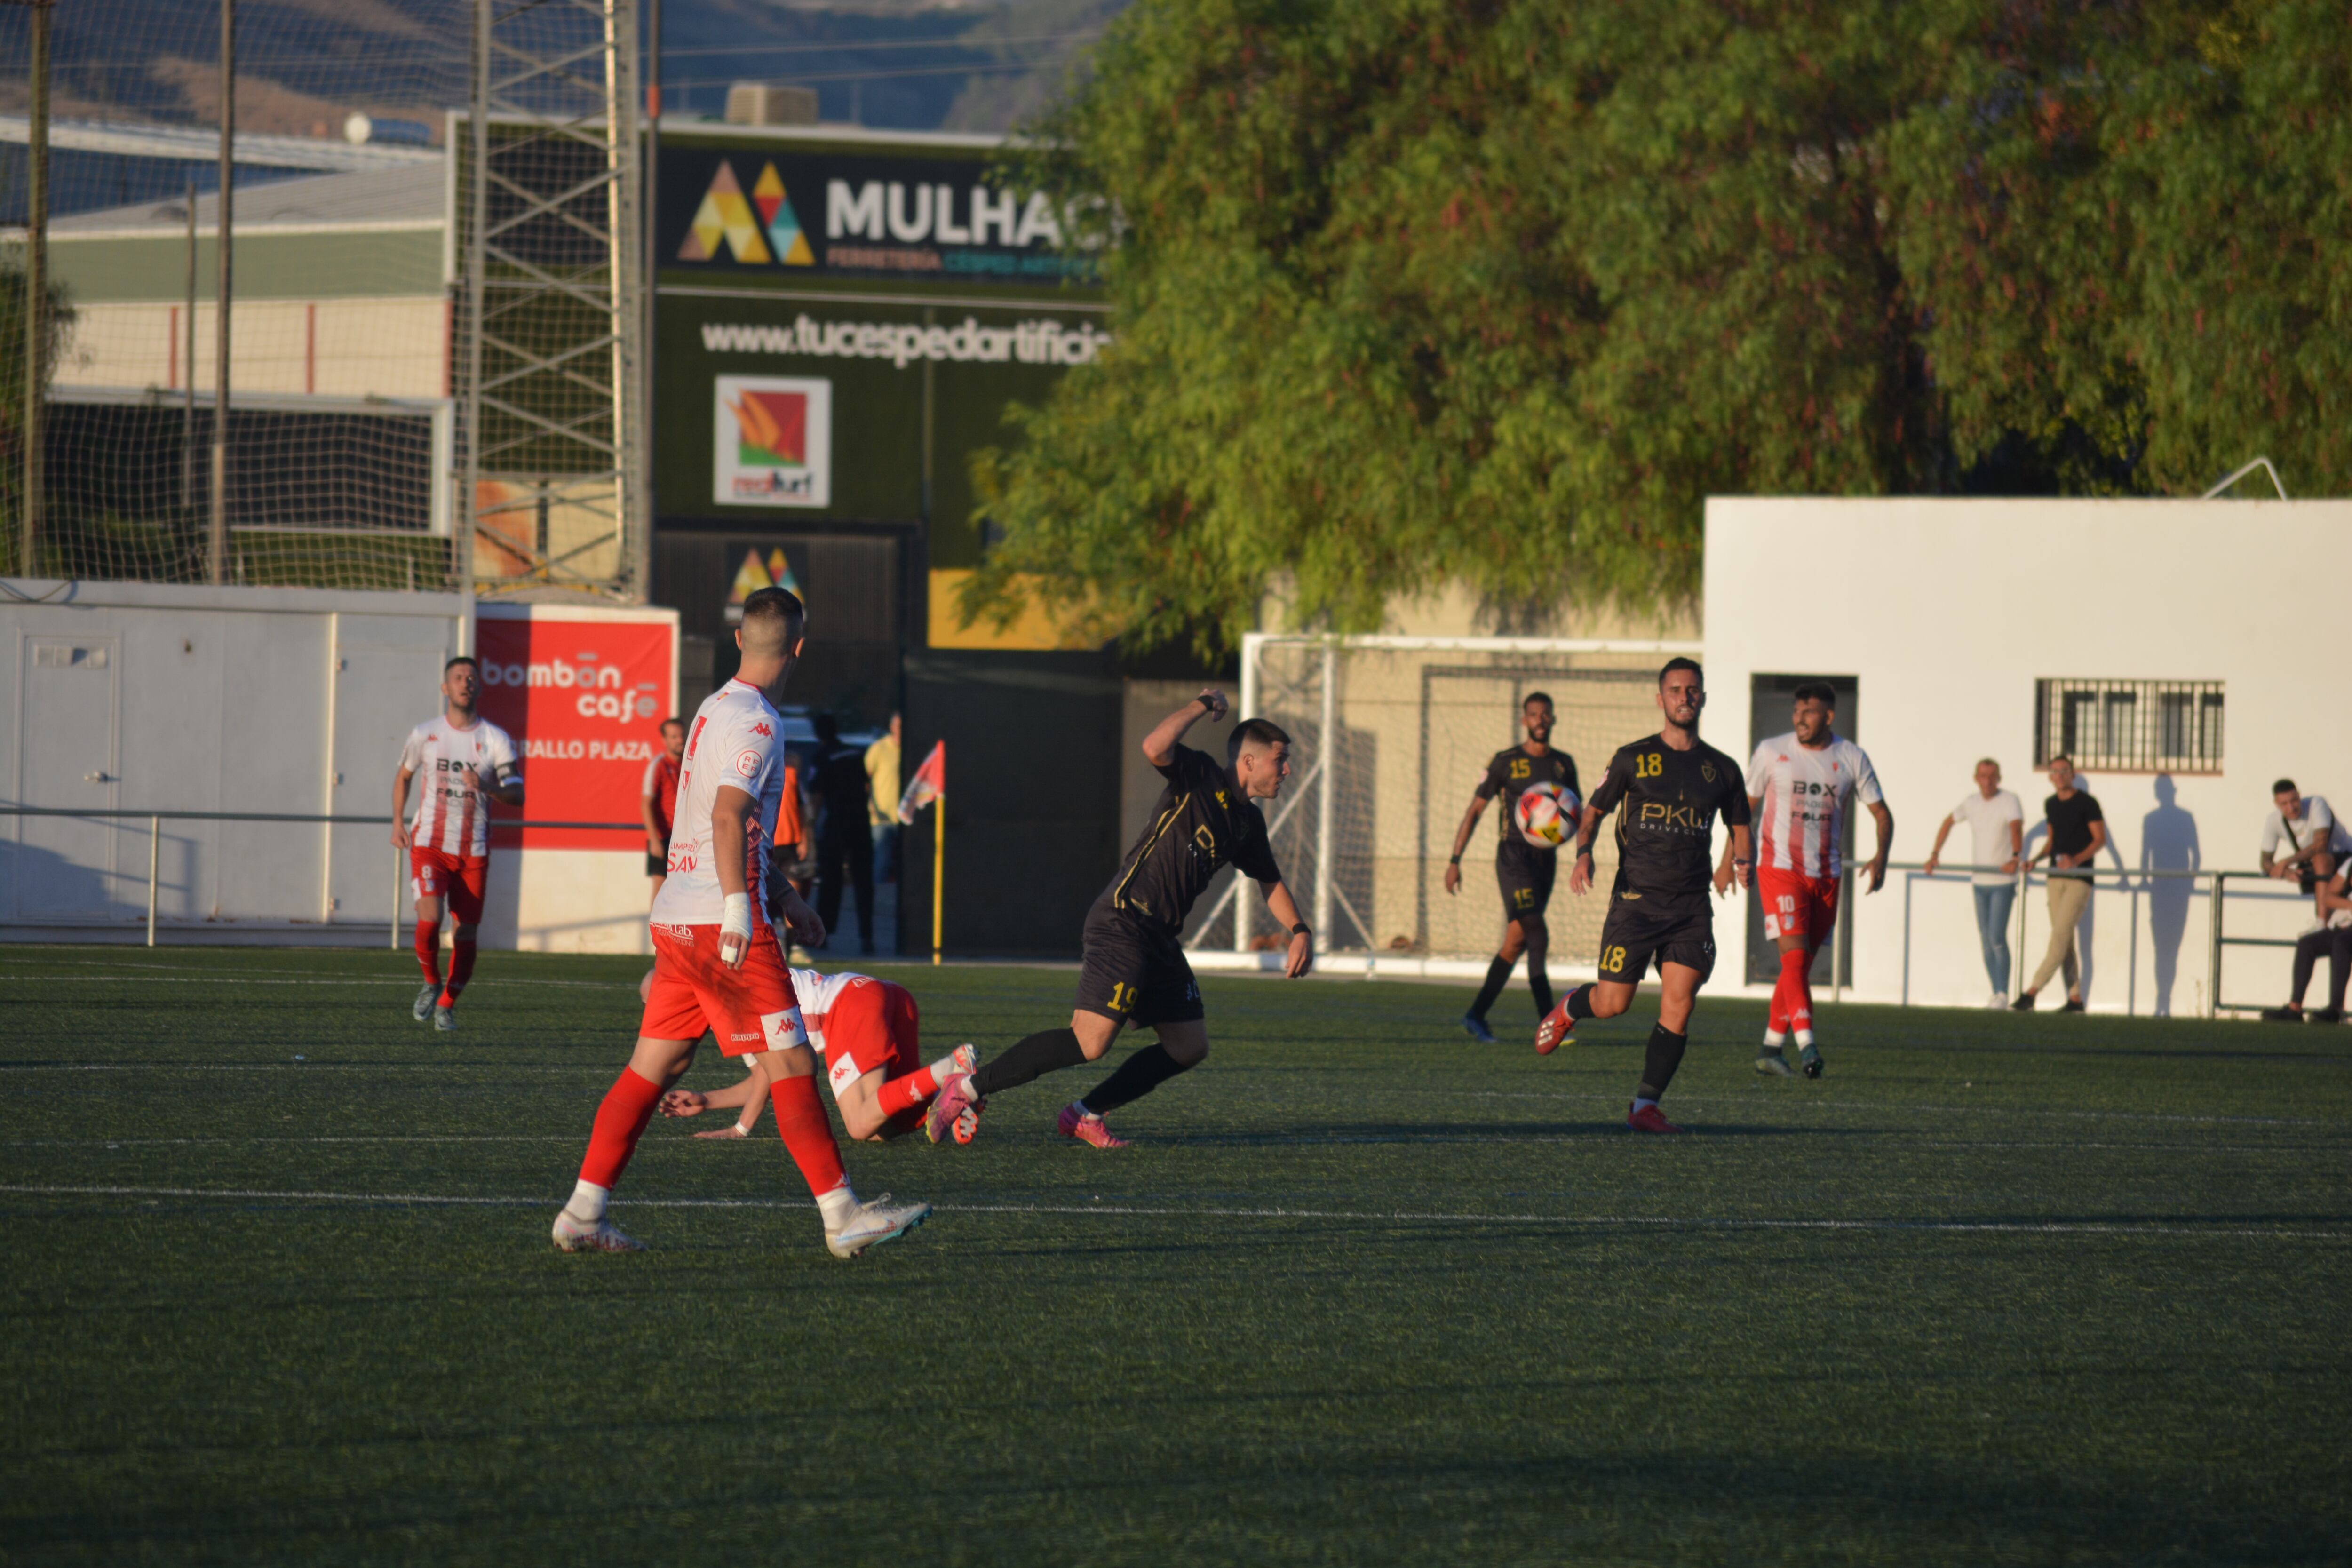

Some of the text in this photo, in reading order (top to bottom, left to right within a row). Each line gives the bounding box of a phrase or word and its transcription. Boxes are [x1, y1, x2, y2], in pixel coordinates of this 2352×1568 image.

[589, 740, 652, 761] PLAZA
[1510, 759, 1531, 779] 15
[1636, 754, 1662, 778] 18
[1793, 781, 1837, 797] BOX
[421, 865, 432, 879] 8
[1513, 888, 1535, 909] 15
[1776, 895, 1795, 913] 10
[1600, 945, 1626, 973] 18
[1107, 981, 1138, 1013] 19
